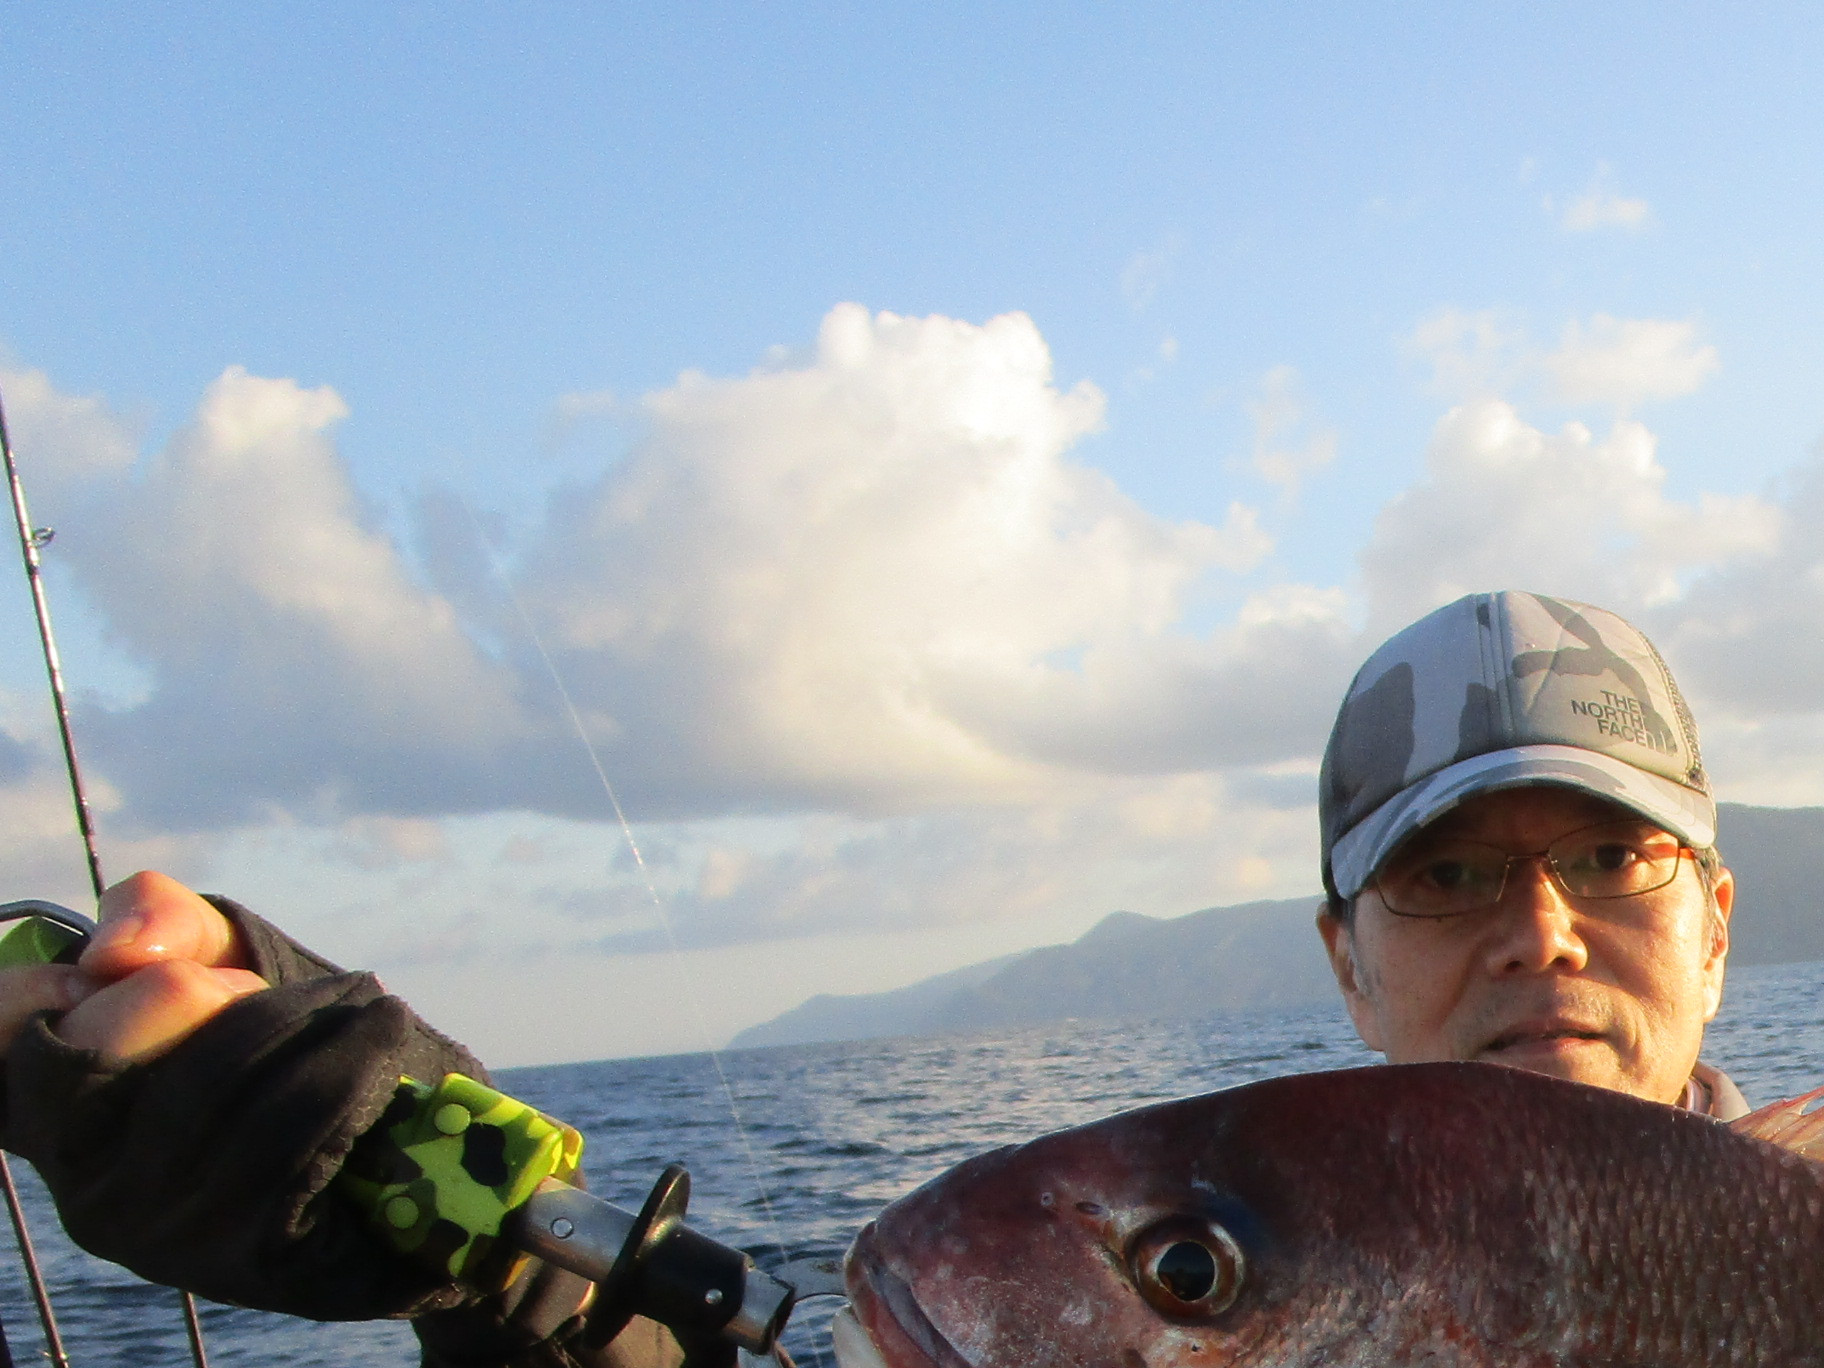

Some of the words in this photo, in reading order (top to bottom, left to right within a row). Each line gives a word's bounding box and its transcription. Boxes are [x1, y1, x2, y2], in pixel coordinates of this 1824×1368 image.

[1571, 700, 1644, 730] NORTH
[1600, 690, 1640, 713] THE
[1597, 719, 1647, 747] FACE
